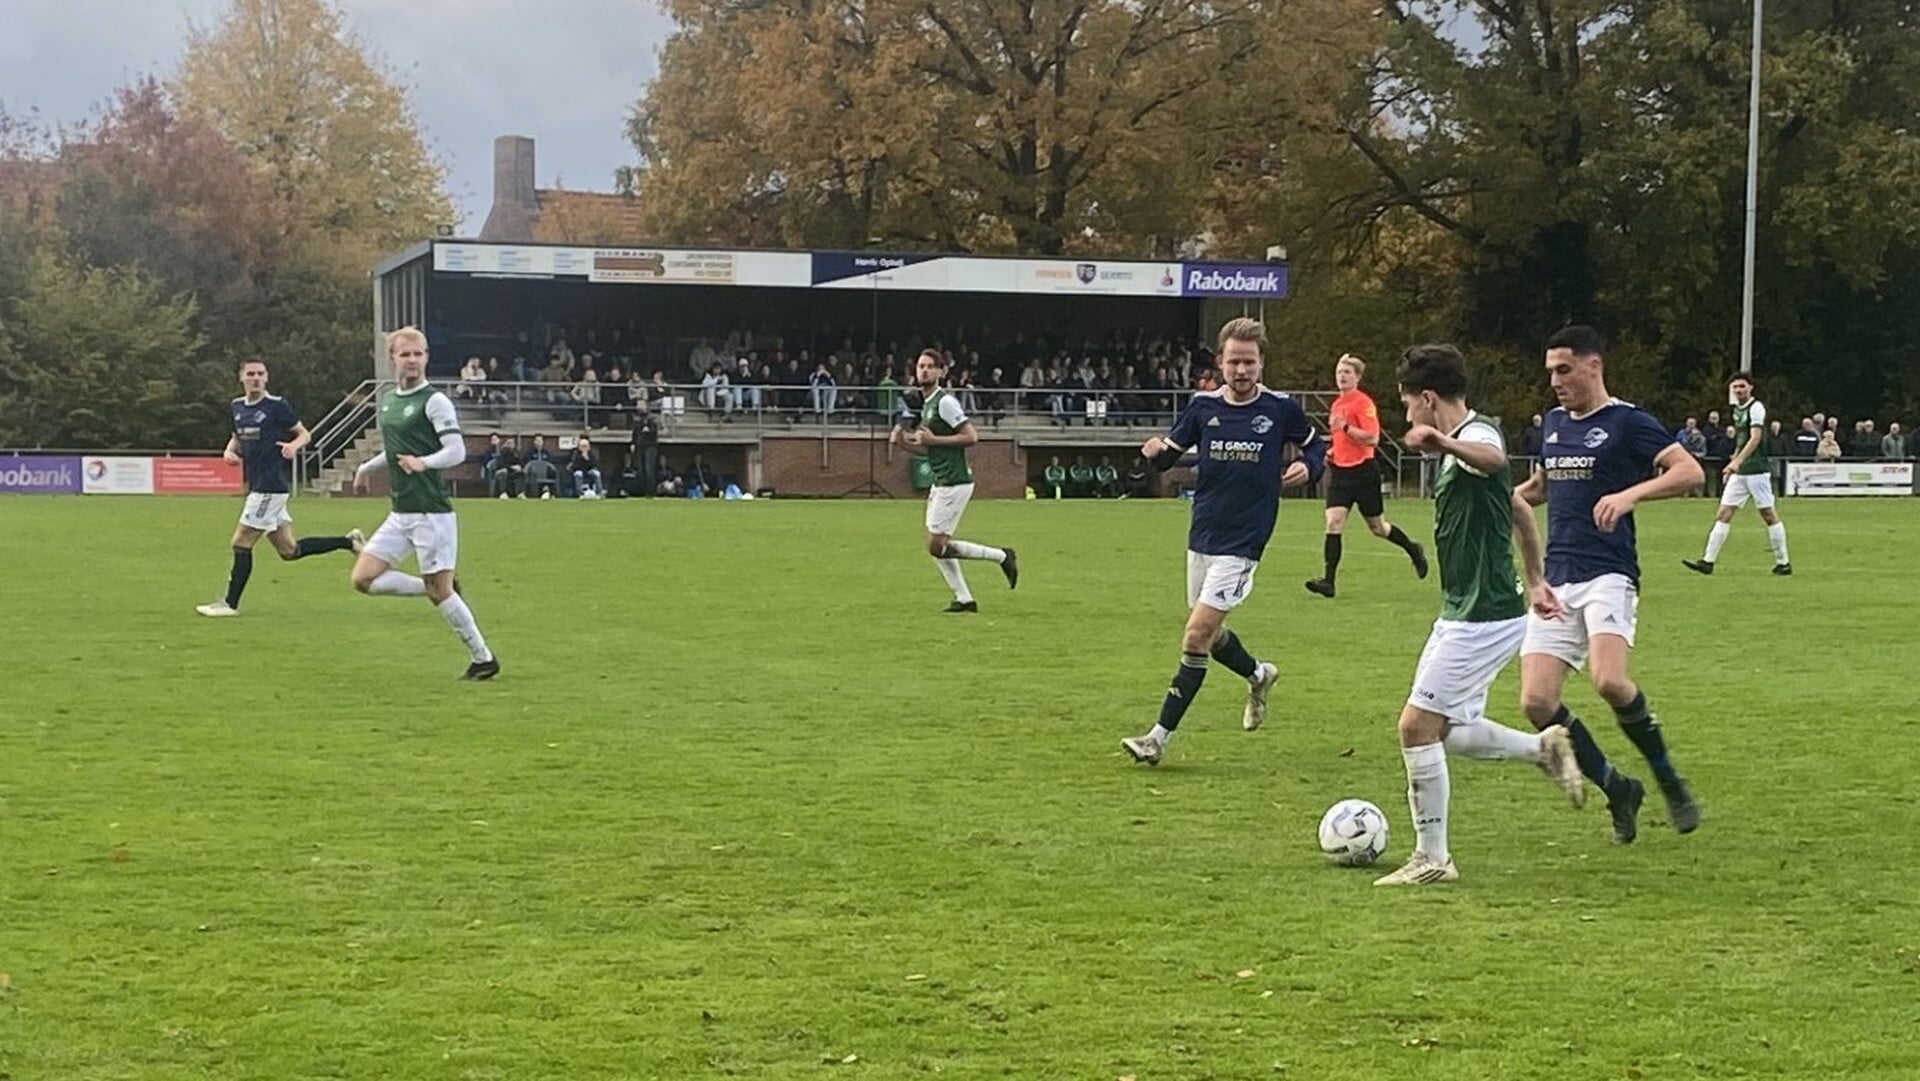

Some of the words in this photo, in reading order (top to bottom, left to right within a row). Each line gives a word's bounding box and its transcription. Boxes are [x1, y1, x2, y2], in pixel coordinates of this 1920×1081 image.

[1188, 270, 1279, 292] Rabobank
[1210, 440, 1224, 451] DE
[1225, 441, 1264, 452] GROOT
[1558, 456, 1596, 468] GROOT
